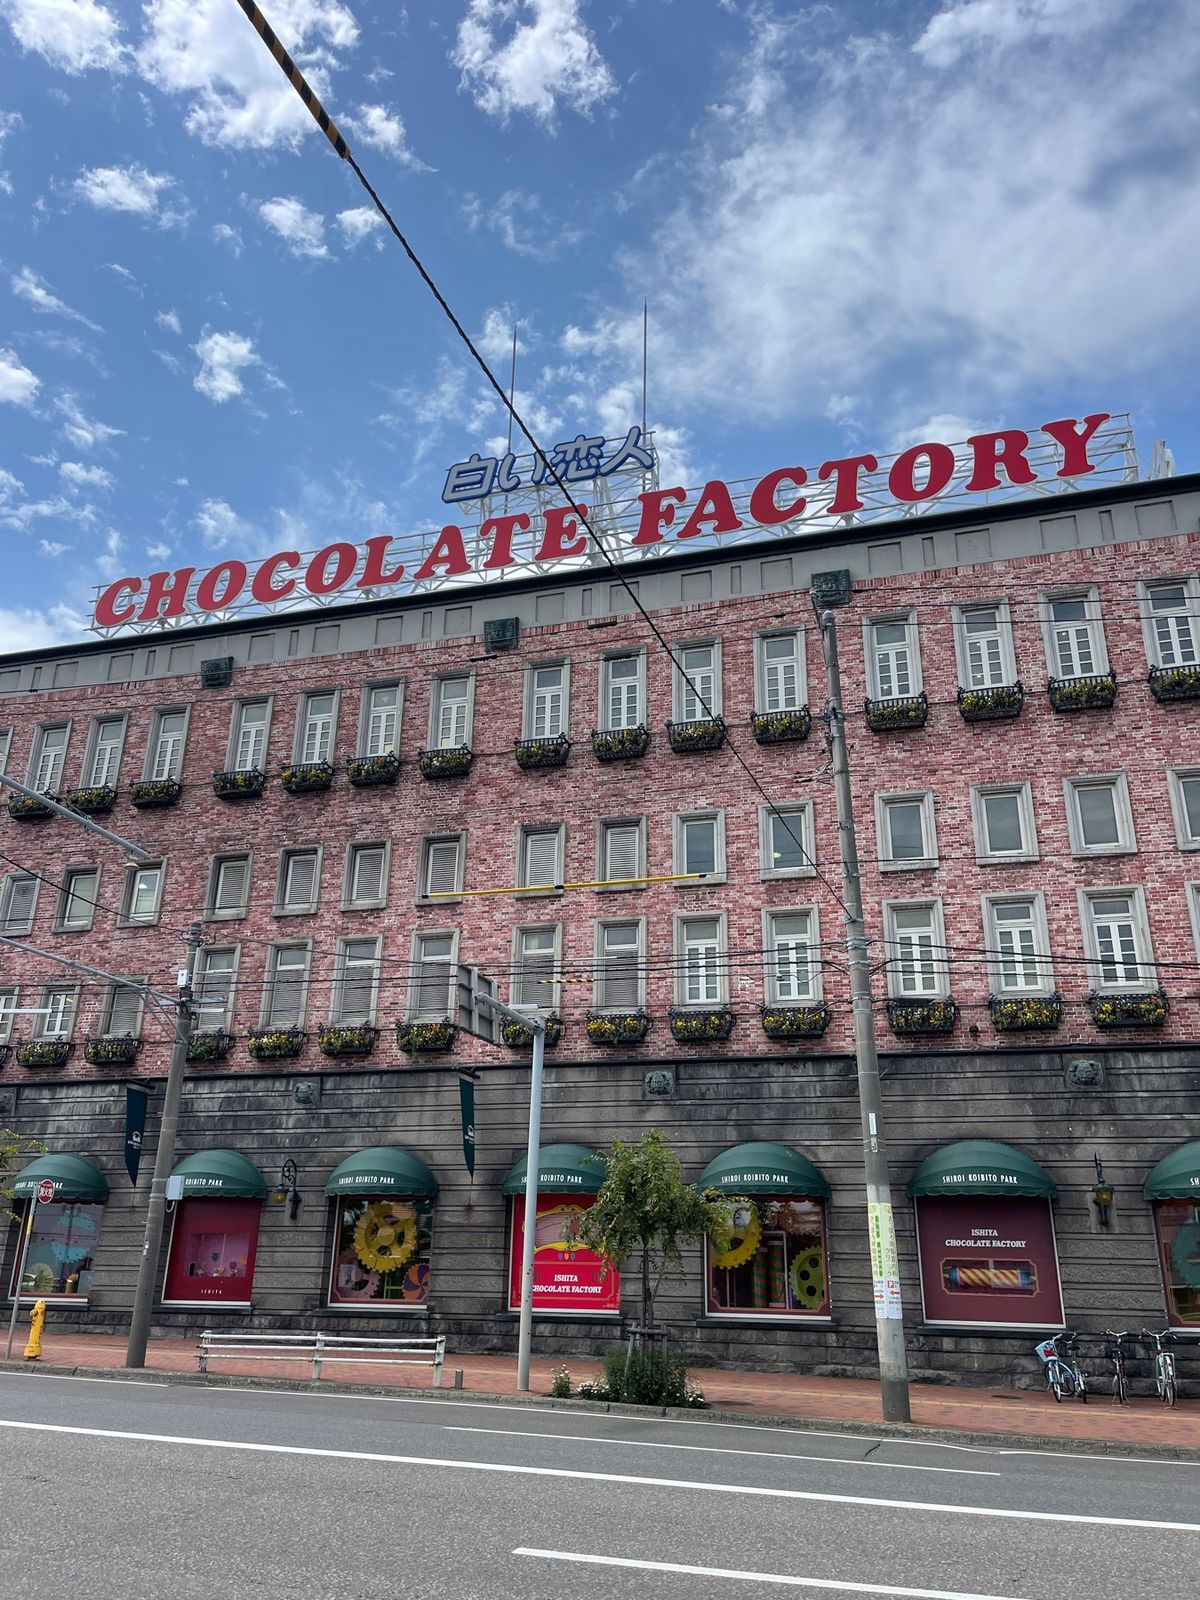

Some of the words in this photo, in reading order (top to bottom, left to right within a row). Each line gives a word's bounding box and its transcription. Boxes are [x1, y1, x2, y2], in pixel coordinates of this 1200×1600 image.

[442, 426, 656, 503] 白い恋人
[94, 506, 588, 651] CHOCOLATE
[632, 412, 1111, 546] FACTORY
[208, 1178, 223, 1187] PARK
[355, 1175, 378, 1183] KOIBITO
[379, 1176, 395, 1185] PARK
[540, 1174, 565, 1182] KOIBITO
[566, 1175, 583, 1184] PARK
[721, 1174, 741, 1184] SHIROI
[743, 1173, 770, 1182] KOIBITO
[772, 1174, 789, 1184] PARK
[942, 1174, 965, 1184] SHIROI
[968, 1173, 998, 1182] KOIBITO
[1000, 1174, 1018, 1184] PARK
[971, 1228, 999, 1237] ISHIYA
[945, 1239, 991, 1247] CHOCOLATE
[992, 1240, 1027, 1248] FACTORY
[554, 1274, 579, 1282] ISHIYA
[571, 1286, 603, 1294] FACTORY
